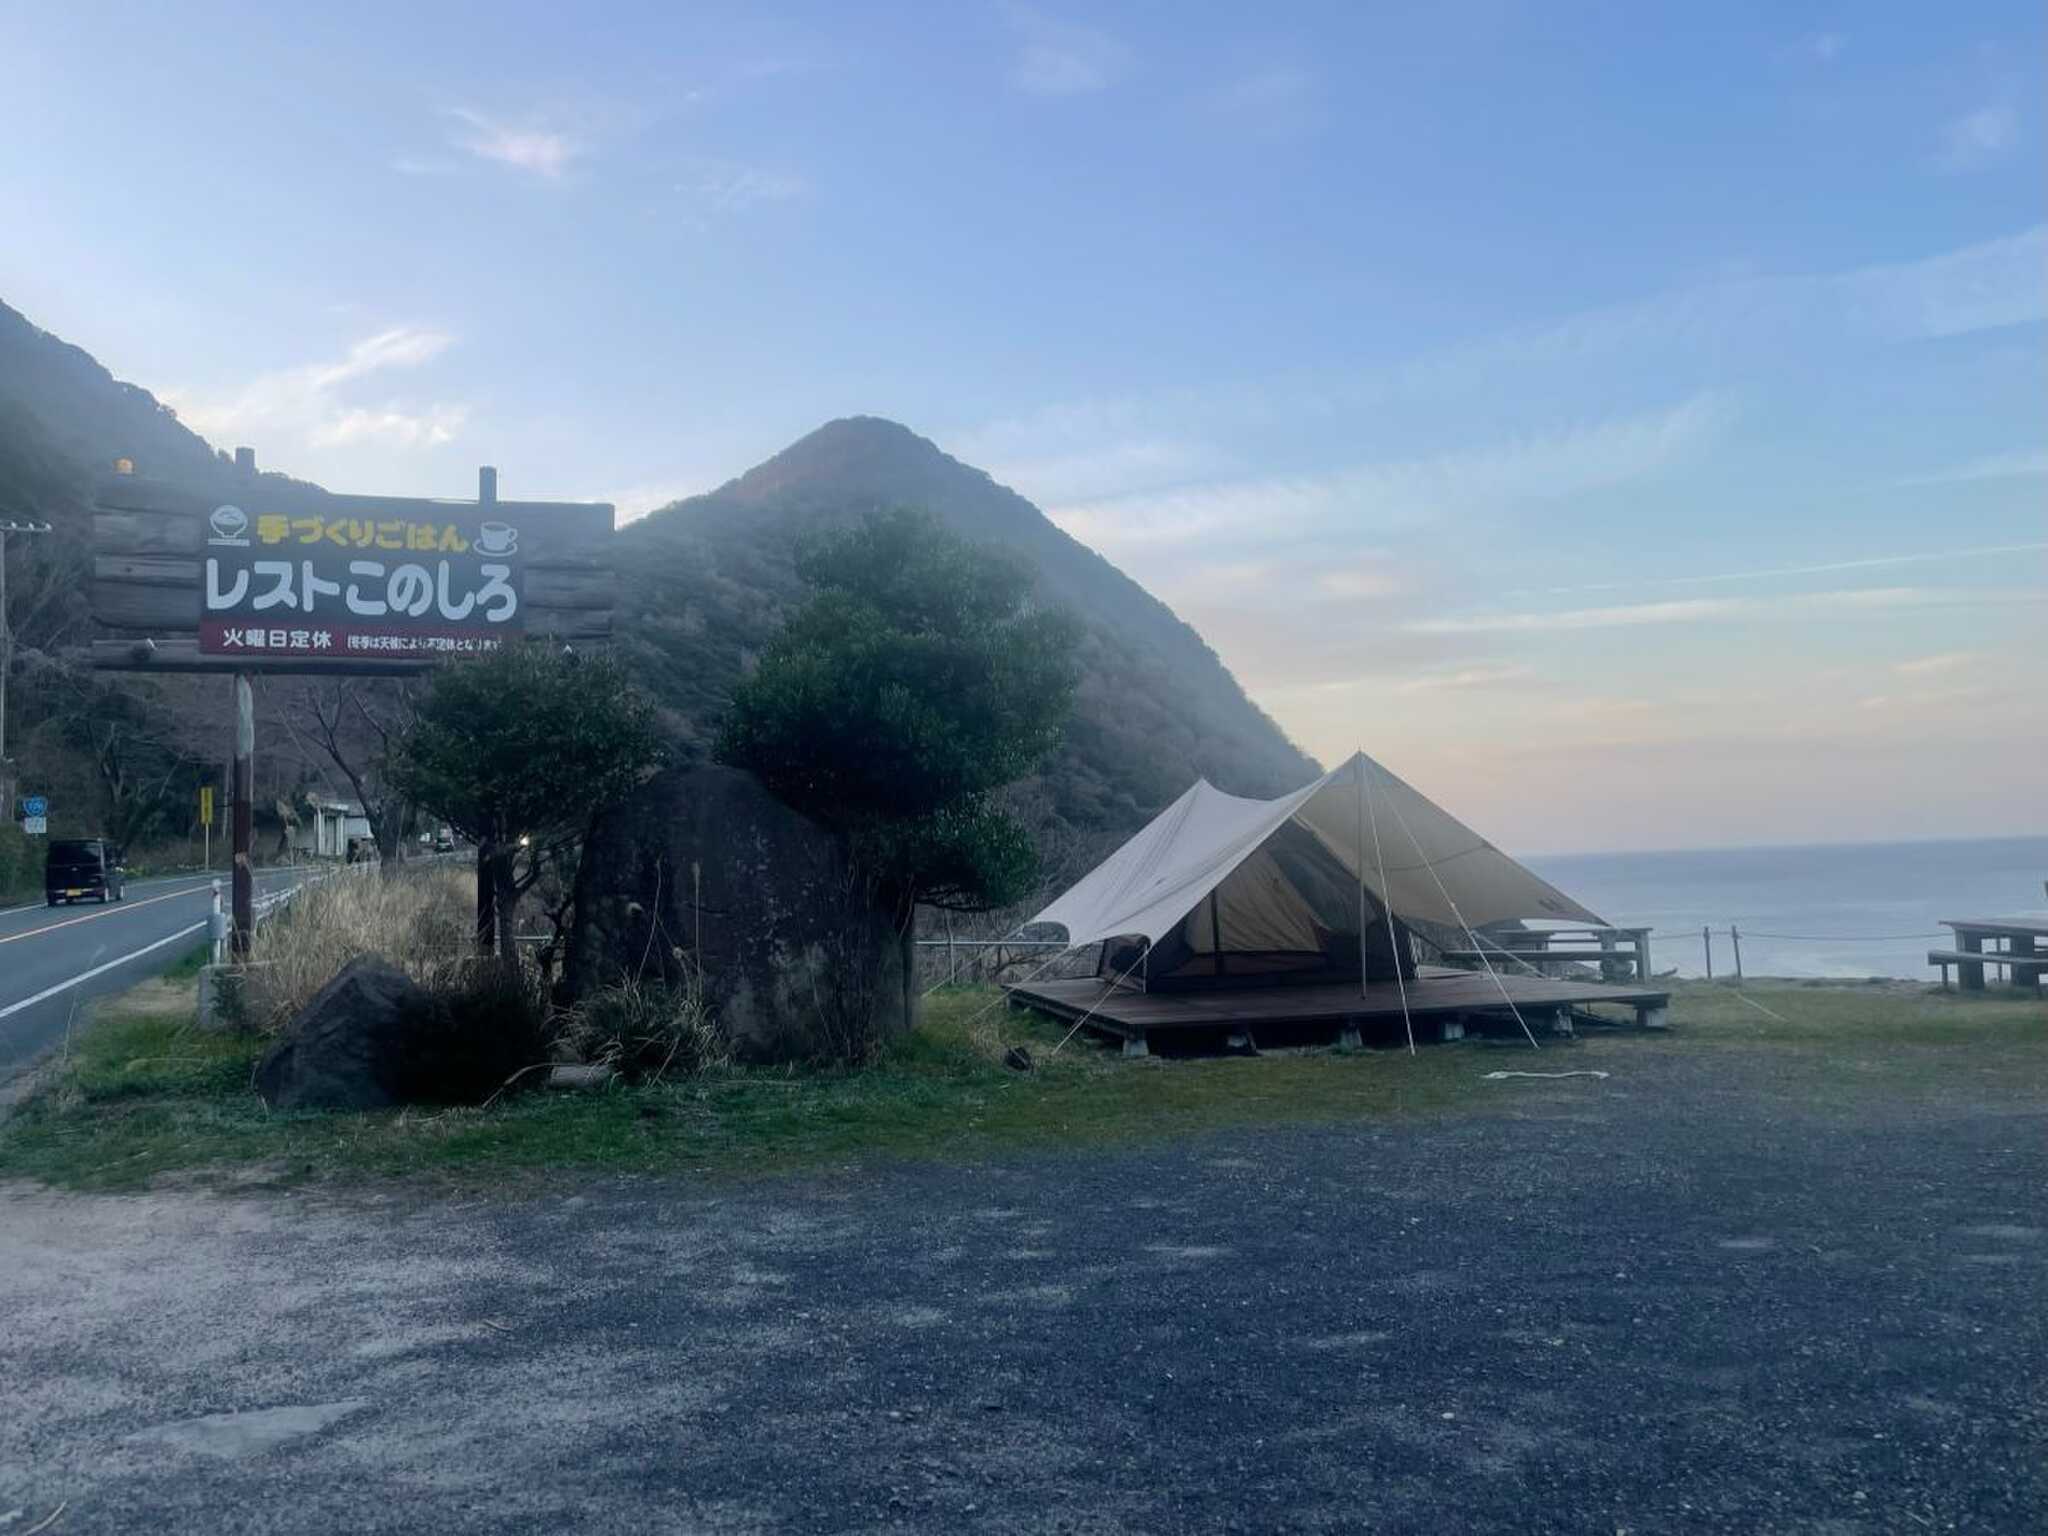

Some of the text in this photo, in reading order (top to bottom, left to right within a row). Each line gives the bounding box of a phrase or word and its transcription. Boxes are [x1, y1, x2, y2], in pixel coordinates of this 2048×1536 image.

[257, 514, 469, 551] 手づくりごはん
[206, 558, 518, 622] レストこのしろ
[222, 629, 332, 648] 火曜日定休
